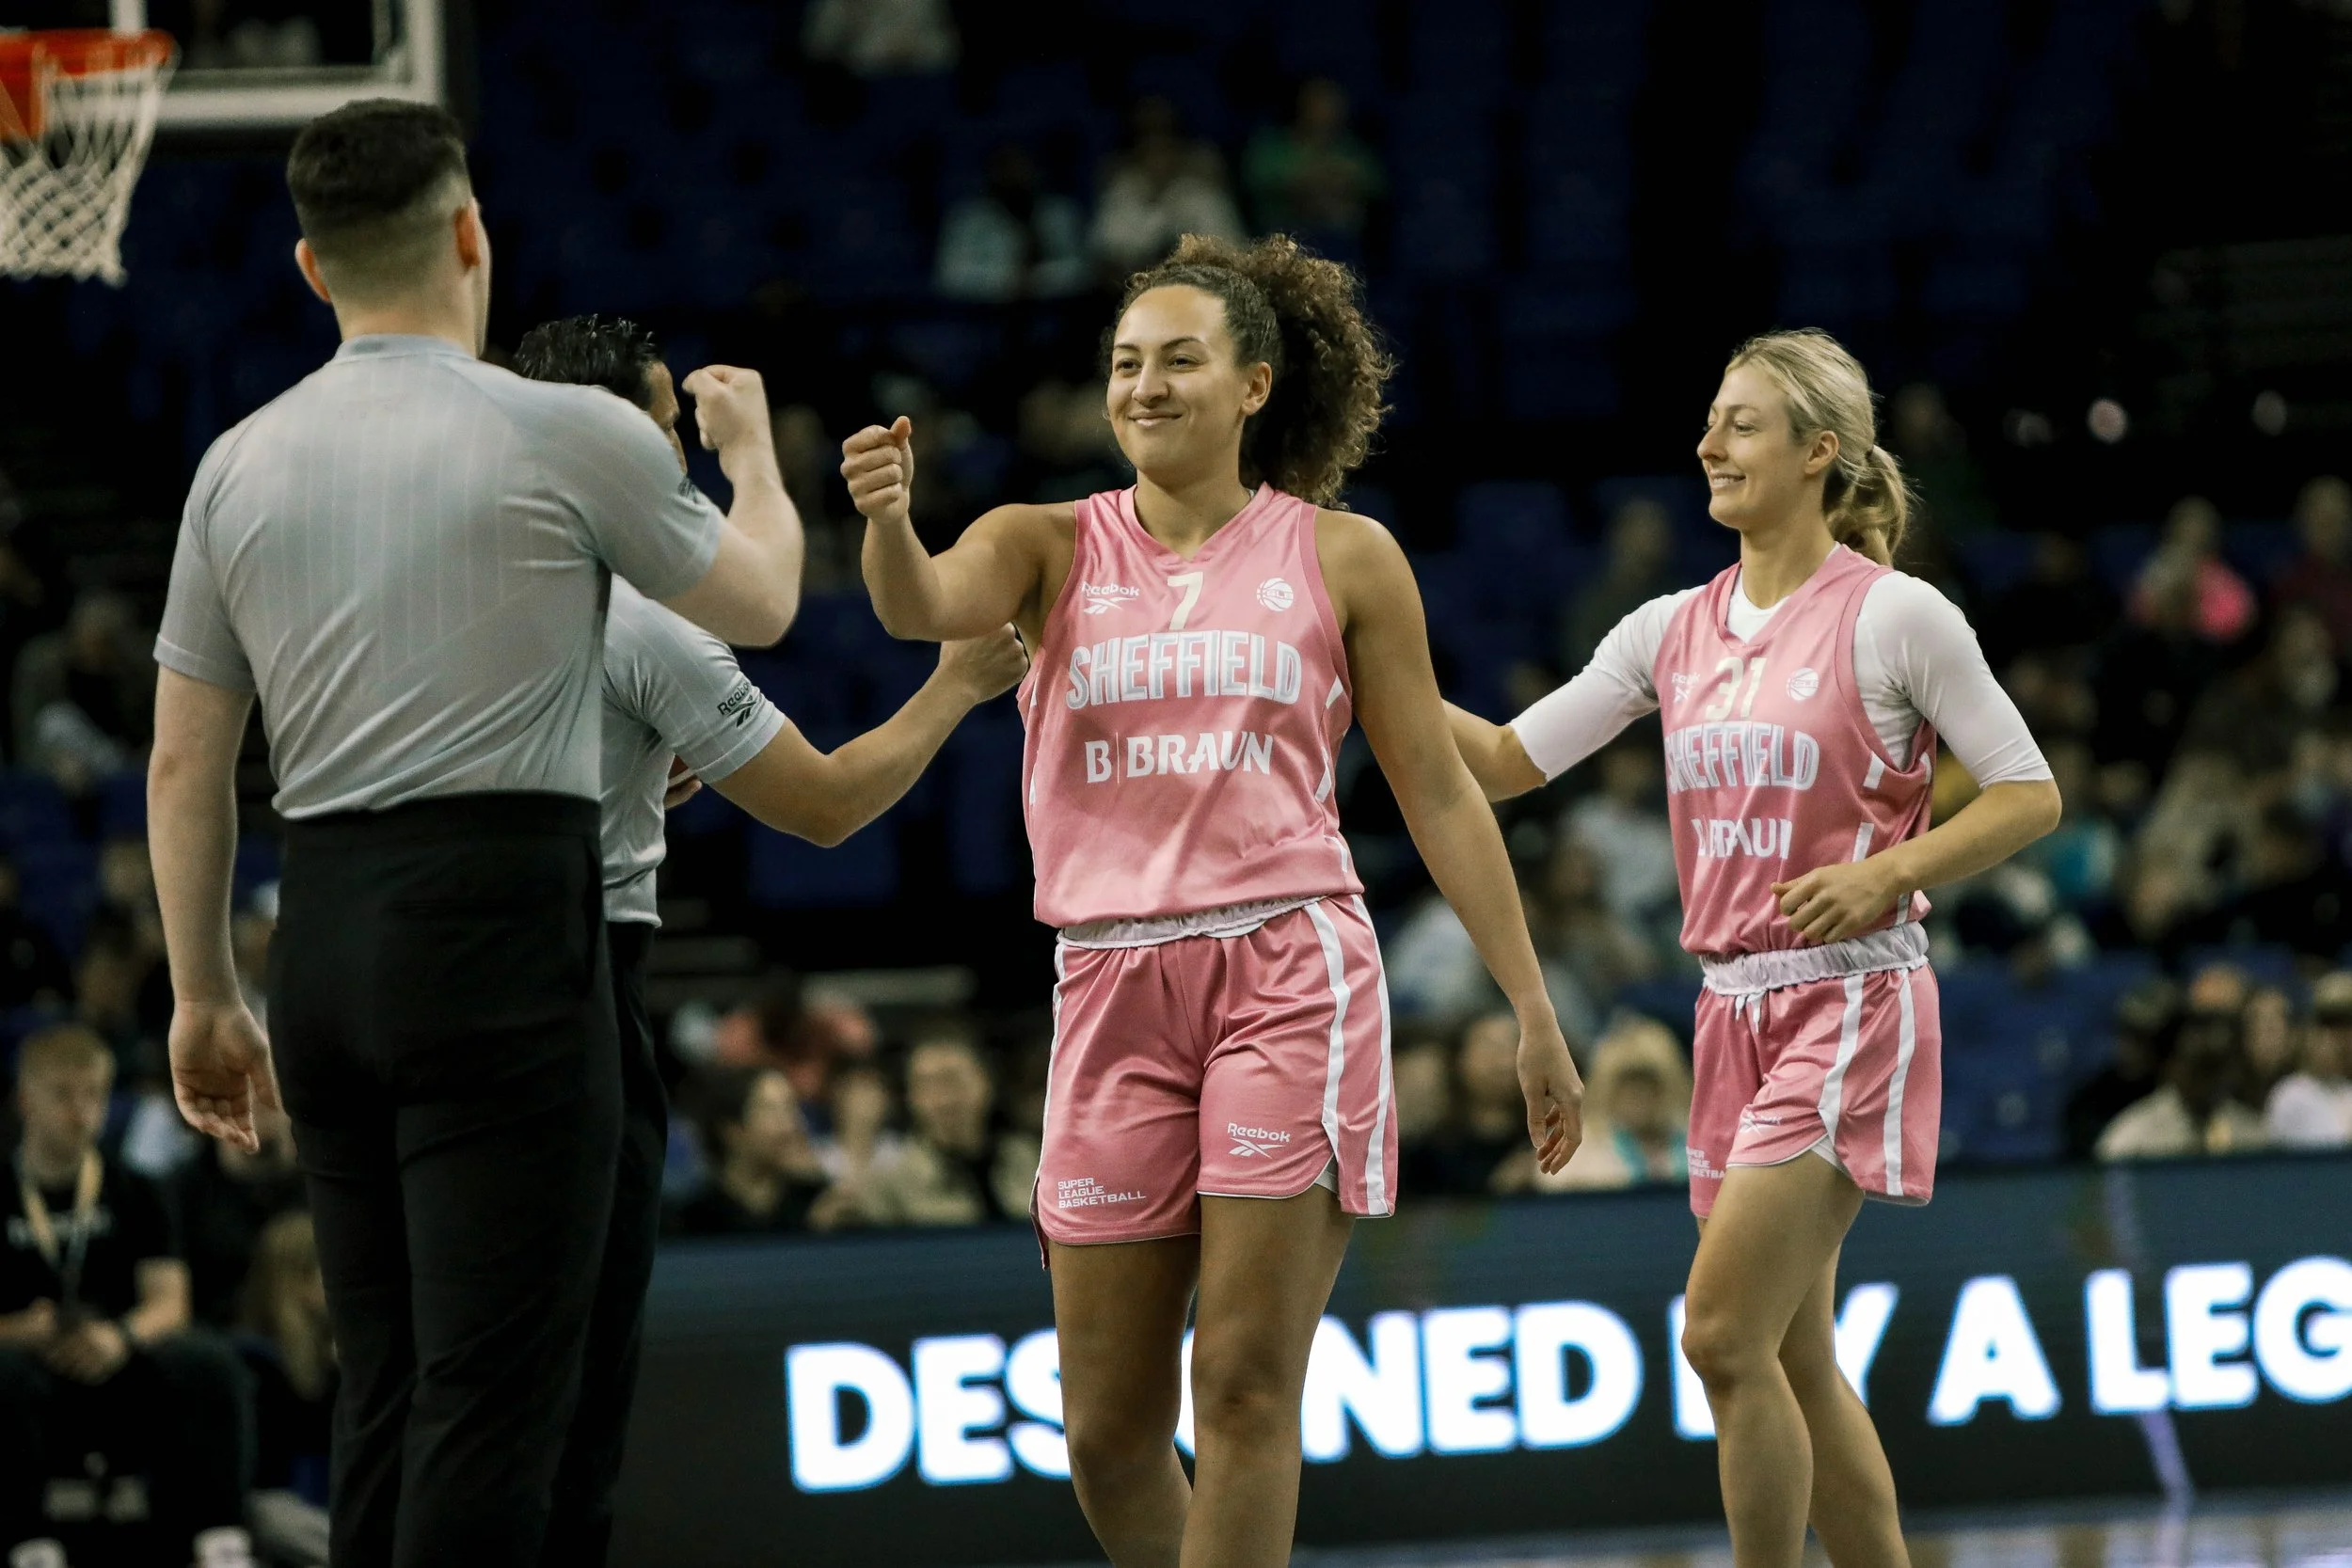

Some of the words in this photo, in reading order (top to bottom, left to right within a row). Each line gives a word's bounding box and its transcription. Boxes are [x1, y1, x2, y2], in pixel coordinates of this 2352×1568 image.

[1082, 581, 1140, 597] Reebok
[1167, 571, 1203, 630] 7
[1065, 629, 1302, 709] SHEFFIELD
[1705, 657, 1768, 721] 31
[1085, 739, 1112, 784] B
[1126, 731, 1274, 778] BRAUN
[1227, 1122, 1291, 1143] Reebok
[1057, 1178, 1094, 1190] SUPER
[1058, 1185, 1104, 1199] LEAGUE
[1058, 1191, 1147, 1209] BASKETBALL
[784, 1298, 1645, 1494] DESNED
[1668, 1281, 1900, 1441] Y
[1926, 1274, 2061, 1427] A
[2084, 1255, 2352, 1417] LEG
